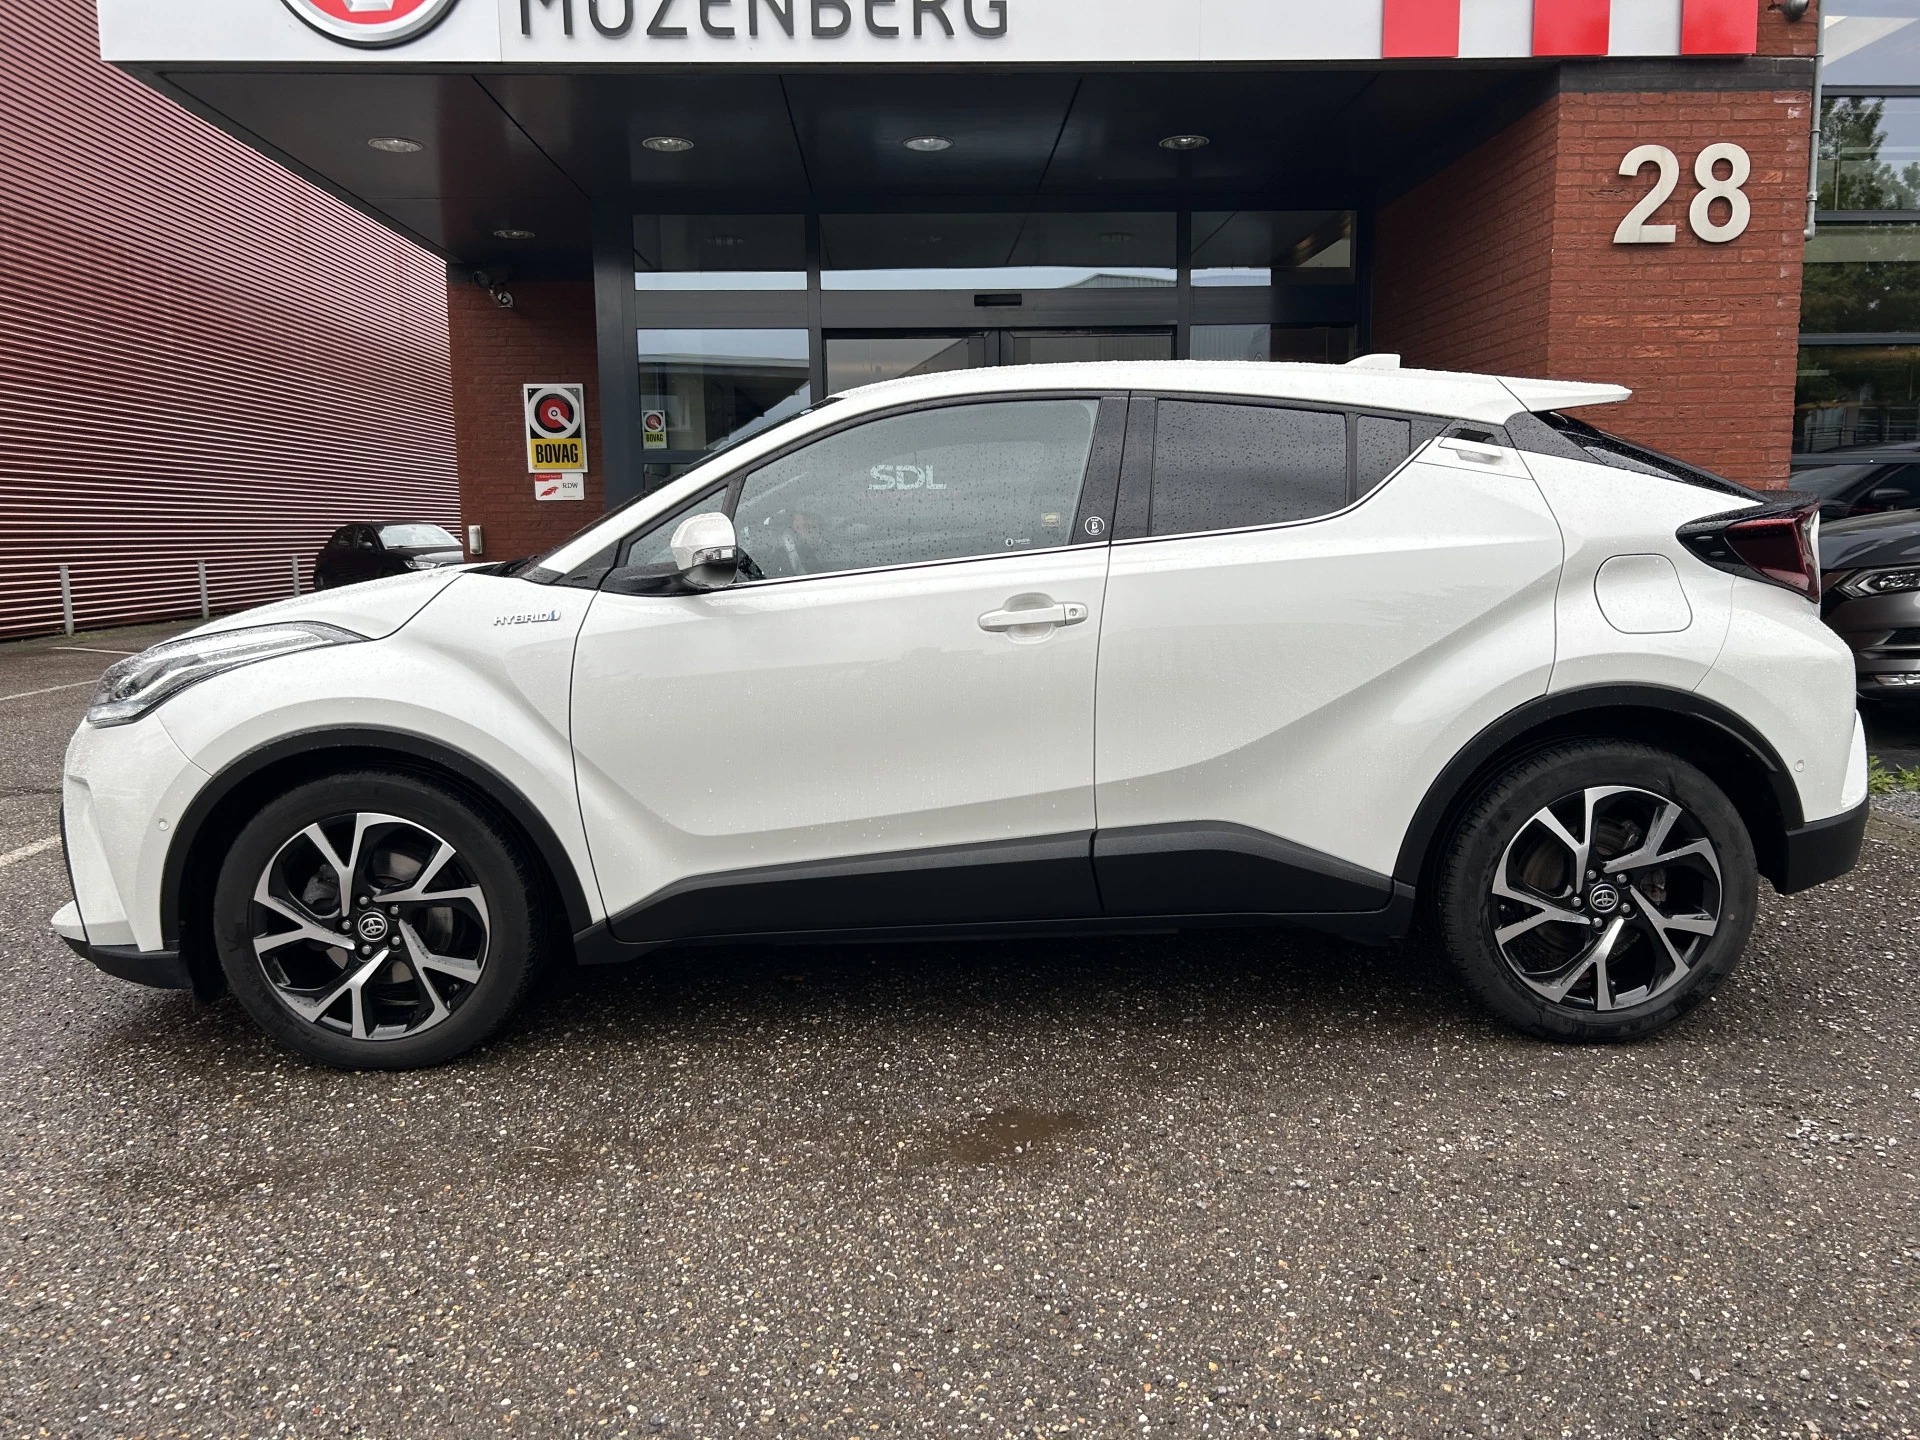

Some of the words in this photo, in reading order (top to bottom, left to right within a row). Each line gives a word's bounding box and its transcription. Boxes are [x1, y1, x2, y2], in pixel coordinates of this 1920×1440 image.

[1613, 142, 1751, 244] 28
[646, 433, 664, 442] BOVAG
[535, 443, 578, 463] BOVAG
[868, 465, 947, 490] SDL
[493, 612, 550, 626] HYBRID
